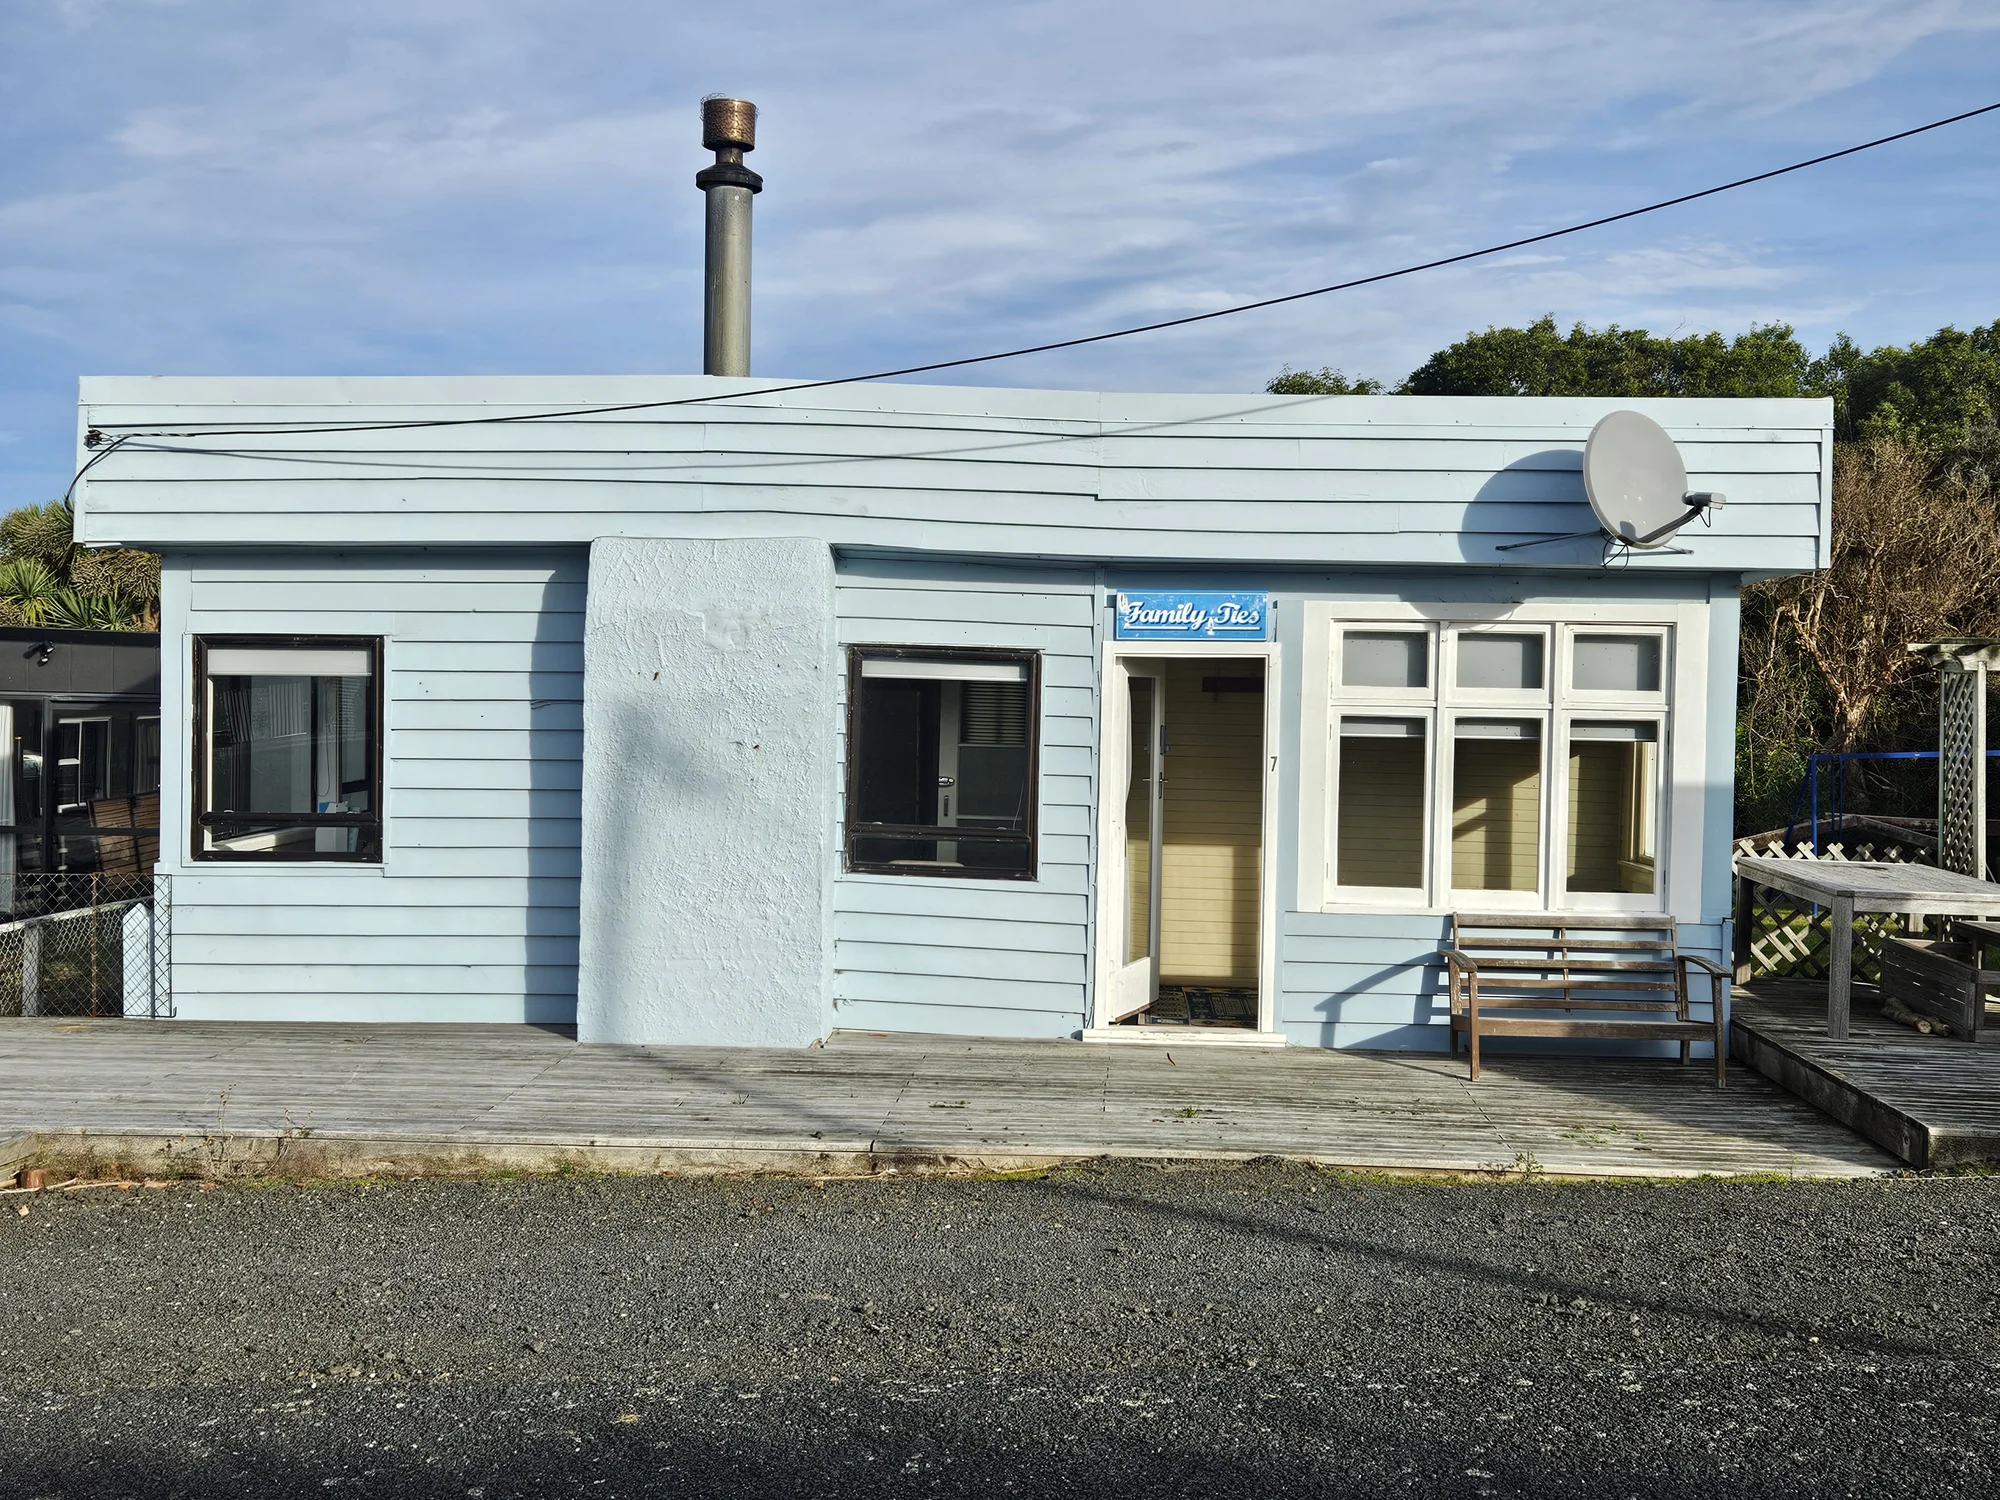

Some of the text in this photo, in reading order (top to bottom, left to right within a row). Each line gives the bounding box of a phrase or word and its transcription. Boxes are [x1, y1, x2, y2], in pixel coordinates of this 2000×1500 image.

[1125, 601, 1262, 630] Family Ties
[1270, 756, 1278, 772] 7
